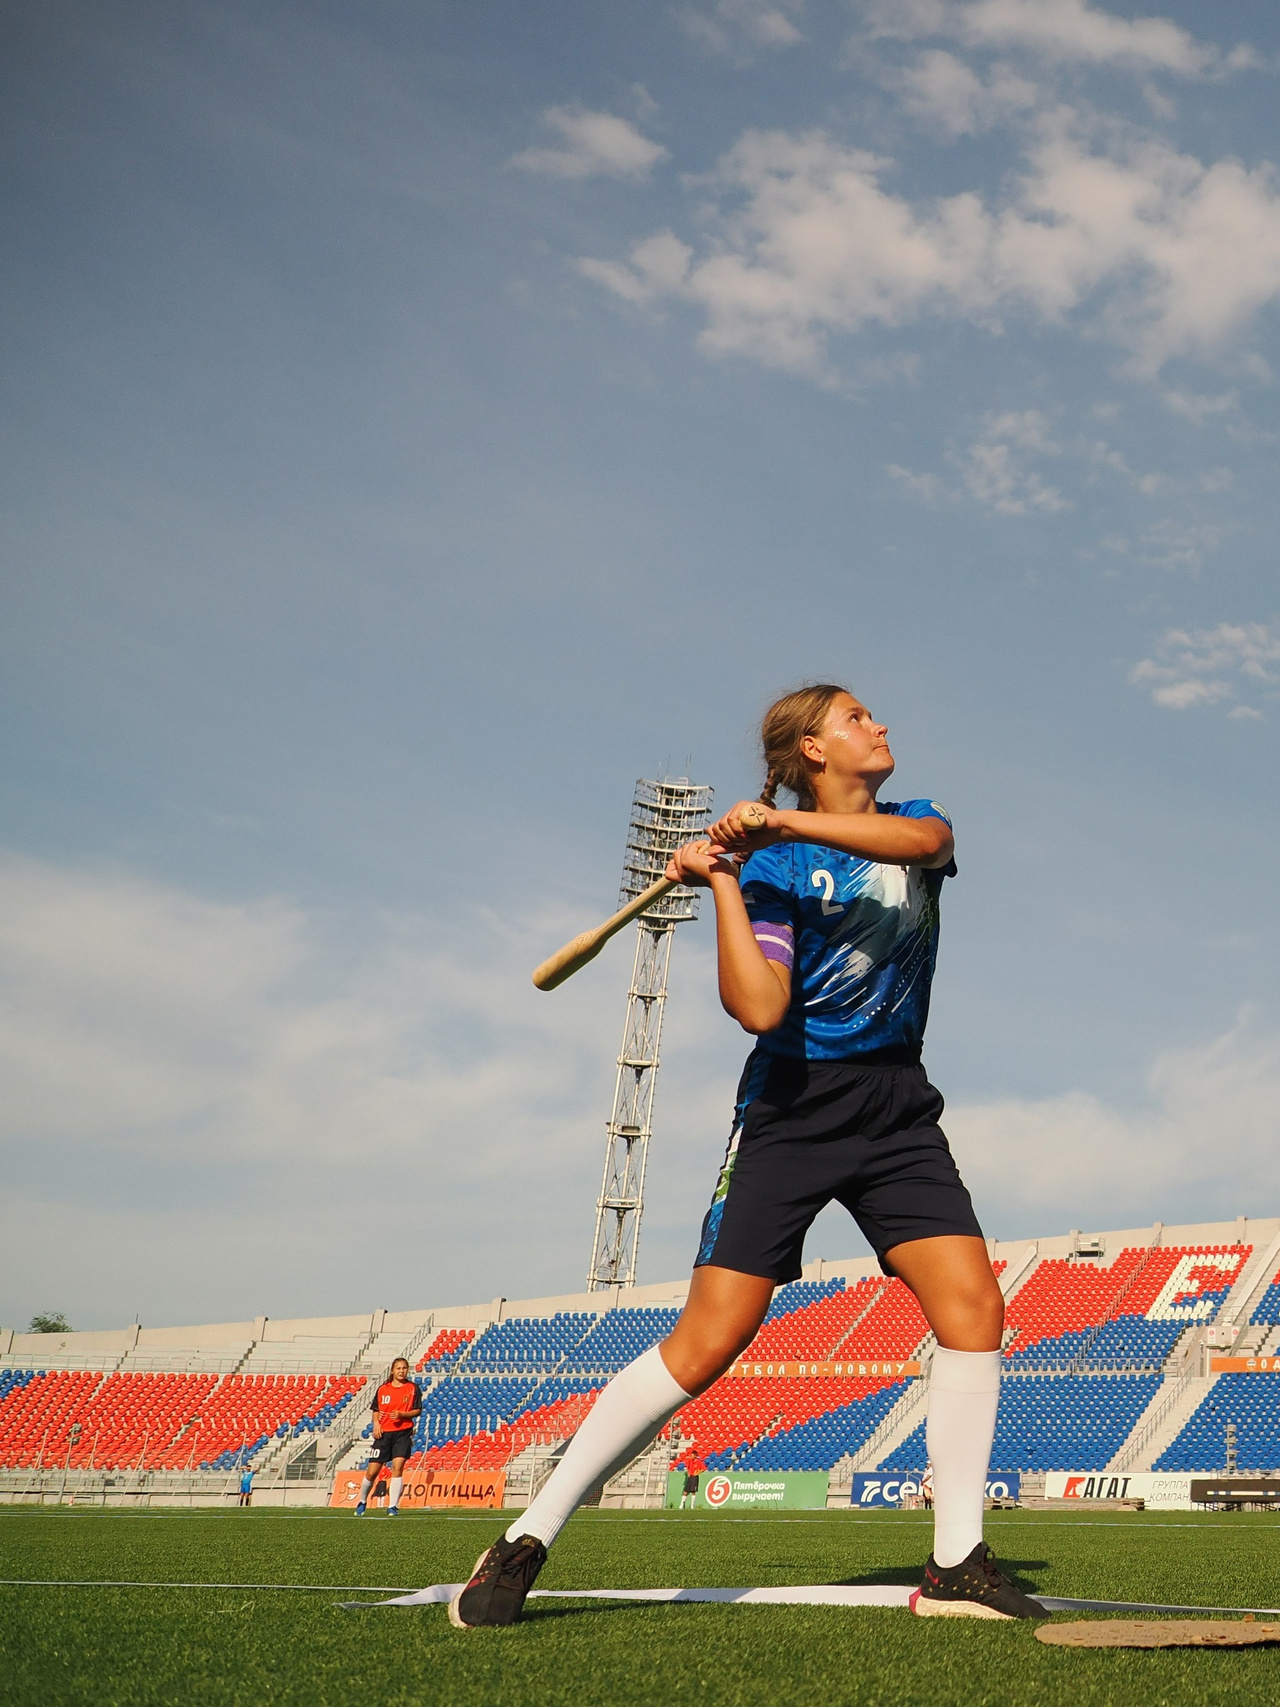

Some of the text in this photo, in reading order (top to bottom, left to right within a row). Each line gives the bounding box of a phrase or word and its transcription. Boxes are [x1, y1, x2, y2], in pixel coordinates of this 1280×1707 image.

[811, 868, 844, 916] 2
[728, 1363, 905, 1375] УТБОЛ ПО-НОВОМУ
[381, 1395, 391, 1405] 10
[711, 1479, 726, 1501] 5
[733, 1481, 785, 1491] Пятёрочка
[1084, 1477, 1132, 1498] АГАТ
[1152, 1480, 1188, 1489] ГРУППА
[430, 1484, 495, 1500] ПИЦЦА
[732, 1492, 784, 1502] выручает!
[1150, 1492, 1190, 1502] КОМПАН
